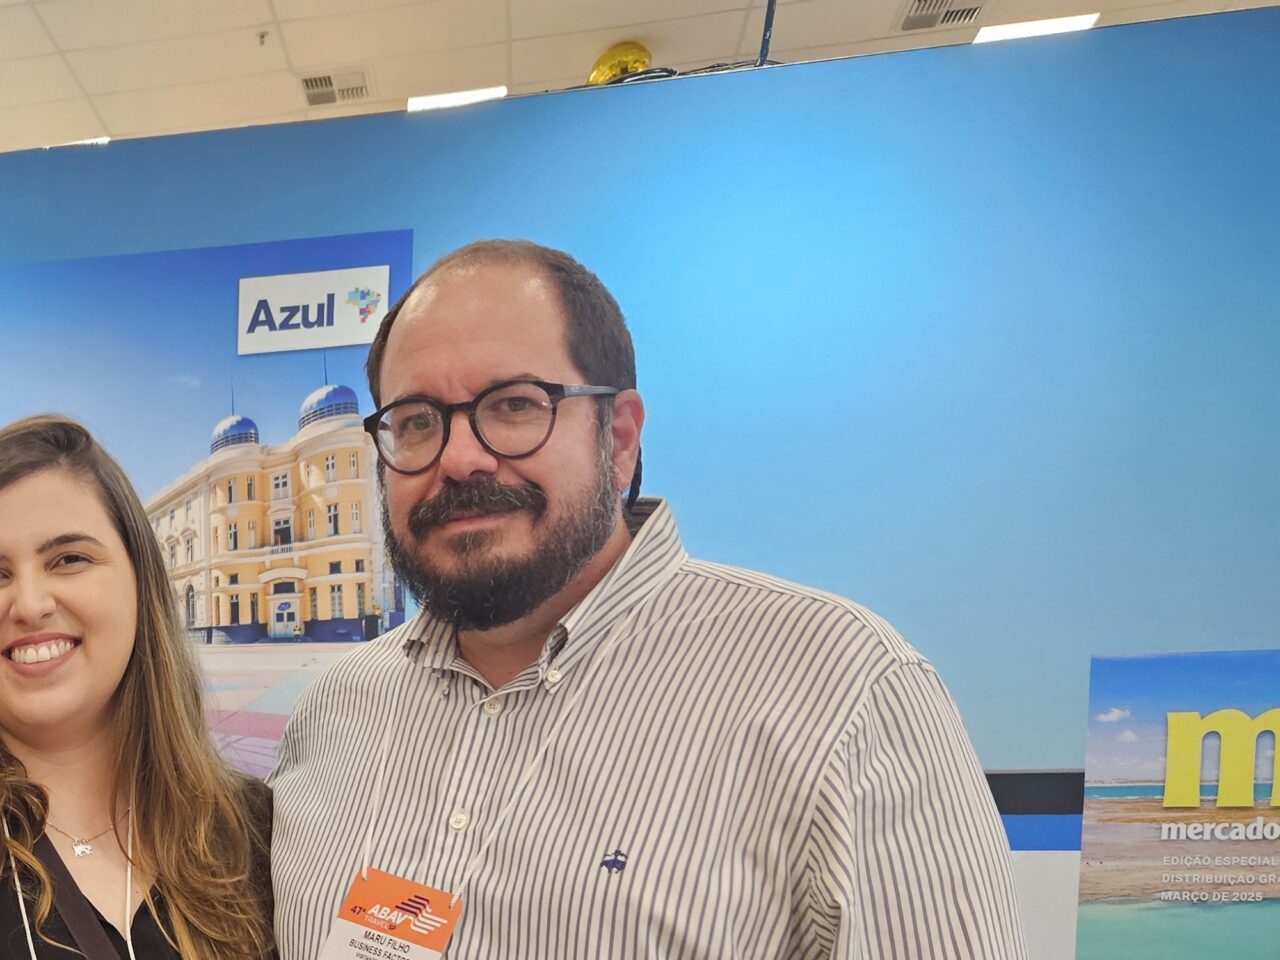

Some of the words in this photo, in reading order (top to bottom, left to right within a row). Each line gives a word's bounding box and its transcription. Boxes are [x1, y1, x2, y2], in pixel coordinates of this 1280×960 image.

[246, 293, 335, 334] Azul
[1163, 855, 1211, 867] EDIÇÃO
[1215, 856, 1278, 866] ESPECIAL
[1162, 873, 1255, 885] DISTRIBUIÇÃO
[1160, 892, 1209, 903] MARÇO
[1213, 892, 1229, 902] DE
[1232, 892, 1263, 902] 2025
[368, 903, 408, 926] ABAV
[349, 938, 382, 957] BUSINESS
[363, 930, 387, 946] MARU
[386, 938, 411, 954] FILHO
